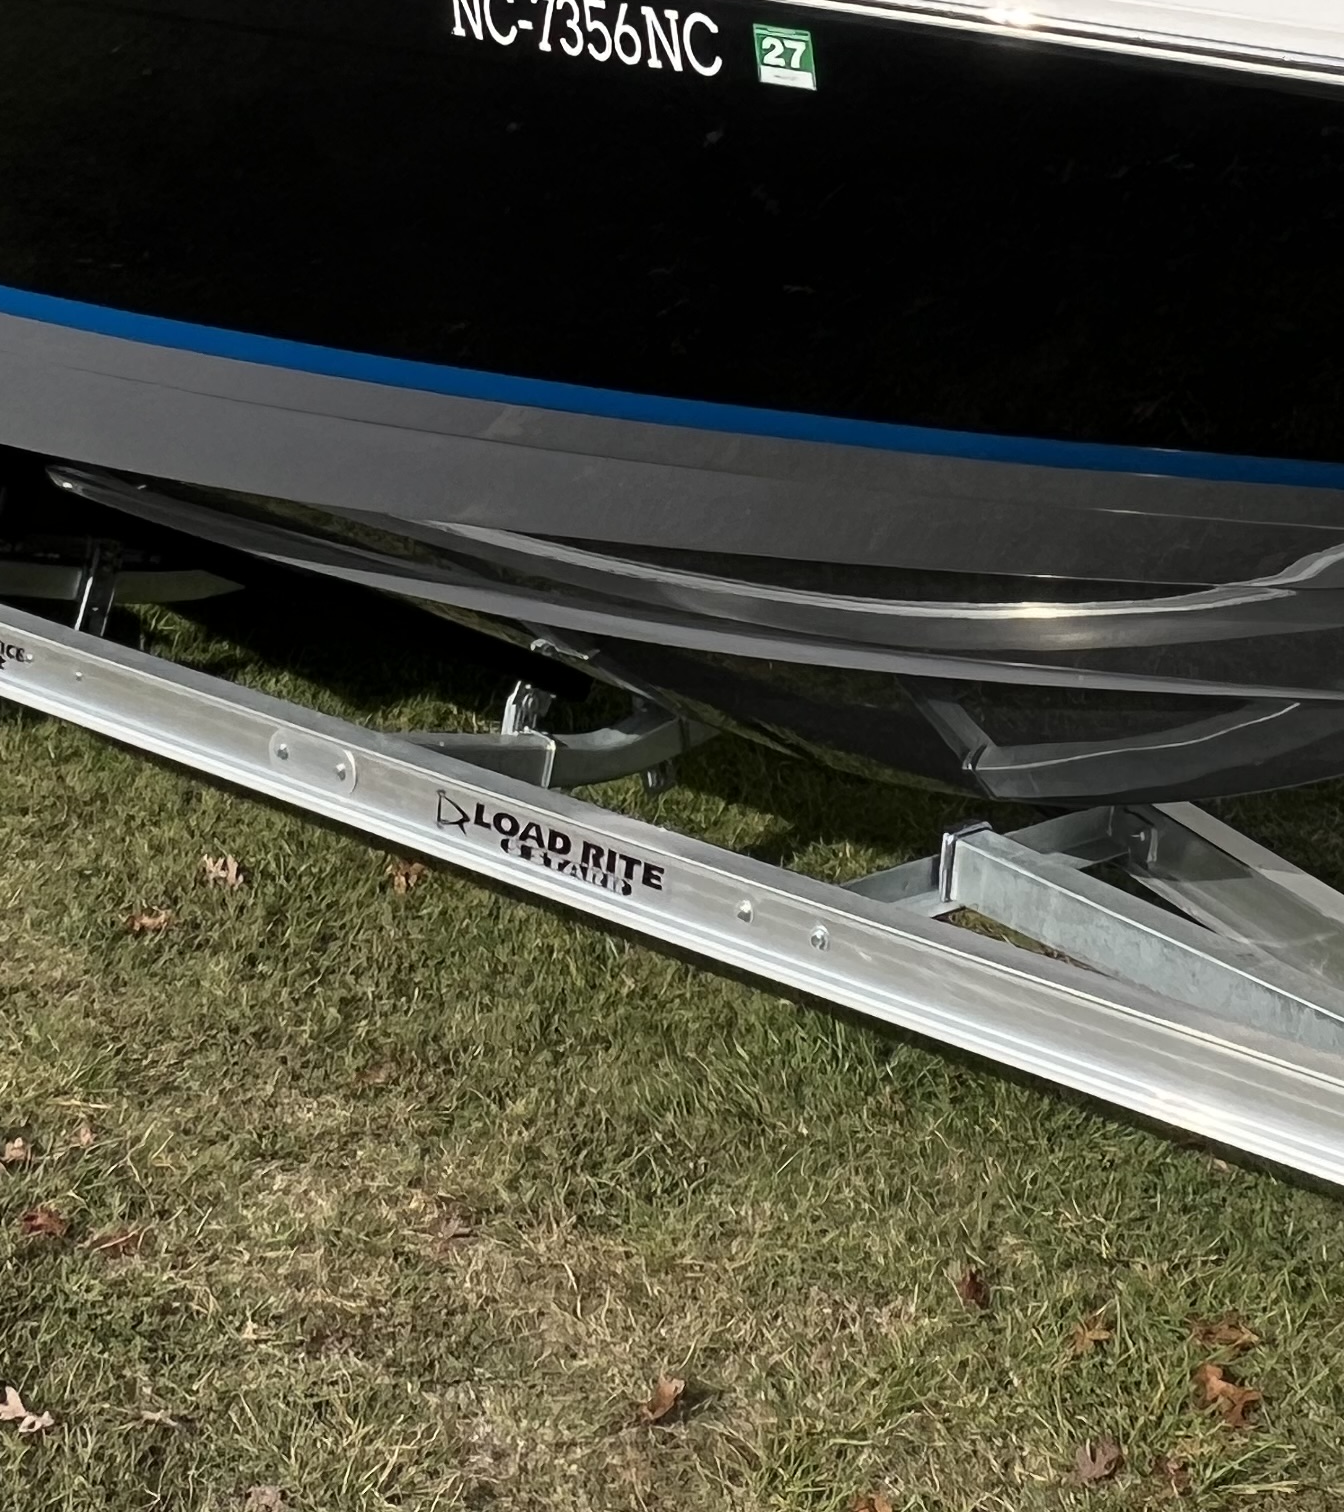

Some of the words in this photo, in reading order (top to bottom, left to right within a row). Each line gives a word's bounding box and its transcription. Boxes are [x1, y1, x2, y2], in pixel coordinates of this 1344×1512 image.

[761, 36, 807, 69] 27
[472, 802, 572, 856] LOAD
[581, 840, 665, 891] RITE
